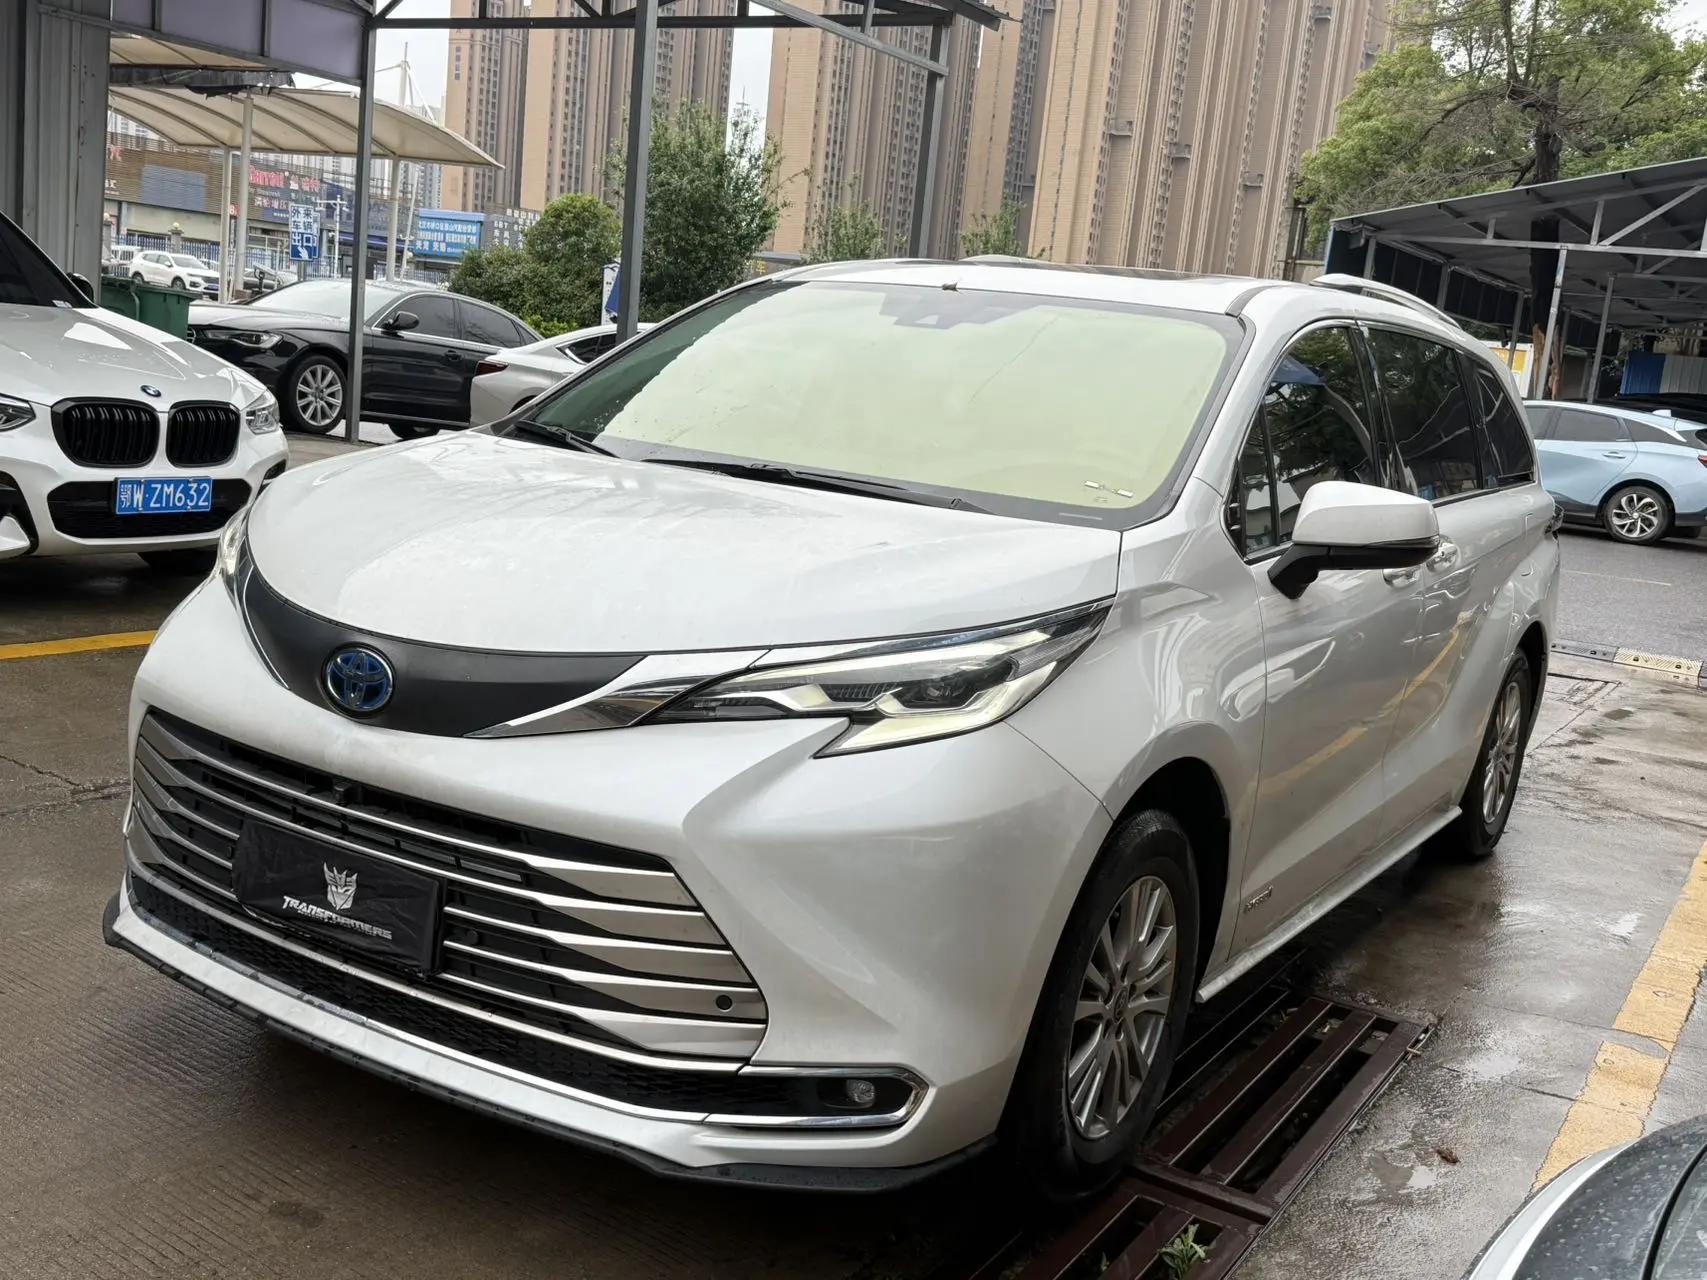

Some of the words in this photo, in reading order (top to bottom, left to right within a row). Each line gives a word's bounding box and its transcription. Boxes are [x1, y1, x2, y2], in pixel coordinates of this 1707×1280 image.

[291, 207, 312, 219] 外来
[291, 220, 312, 232] 车辆
[292, 232, 313, 247] 出口
[282, 895, 393, 940] TRANSFORMERS
